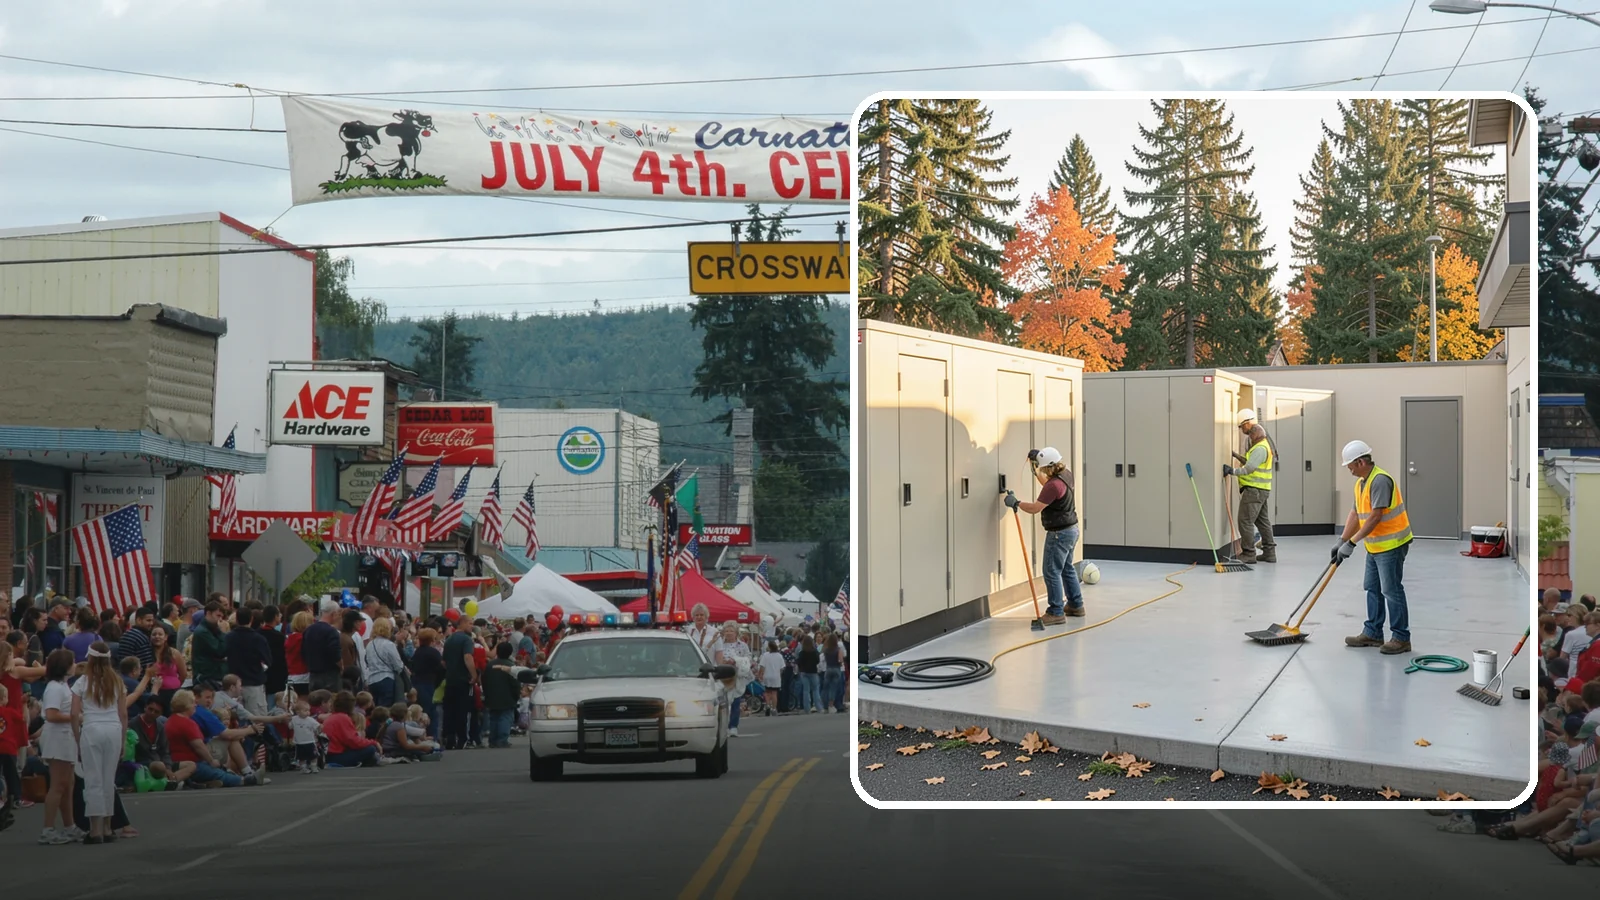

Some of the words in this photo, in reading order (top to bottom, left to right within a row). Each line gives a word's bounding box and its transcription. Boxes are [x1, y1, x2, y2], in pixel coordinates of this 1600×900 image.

[695, 121, 850, 150] Carnat
[481, 141, 605, 193] JULY
[632, 150, 747, 198] 4th.
[697, 255, 850, 280] CROSSWA
[282, 380, 374, 420] ACE
[406, 409, 452, 422] CEDAR
[284, 421, 371, 436] Hardware
[416, 428, 477, 447] Coca-Cola
[353, 467, 385, 480] Simpl
[96, 484, 124, 495] Vincent
[126, 486, 135, 495] de
[138, 486, 155, 496] Paul
[81, 503, 154, 522] THT
[213, 516, 330, 535] HARDARE
[688, 526, 741, 535] CRNATION
[699, 535, 730, 543] GLASS
